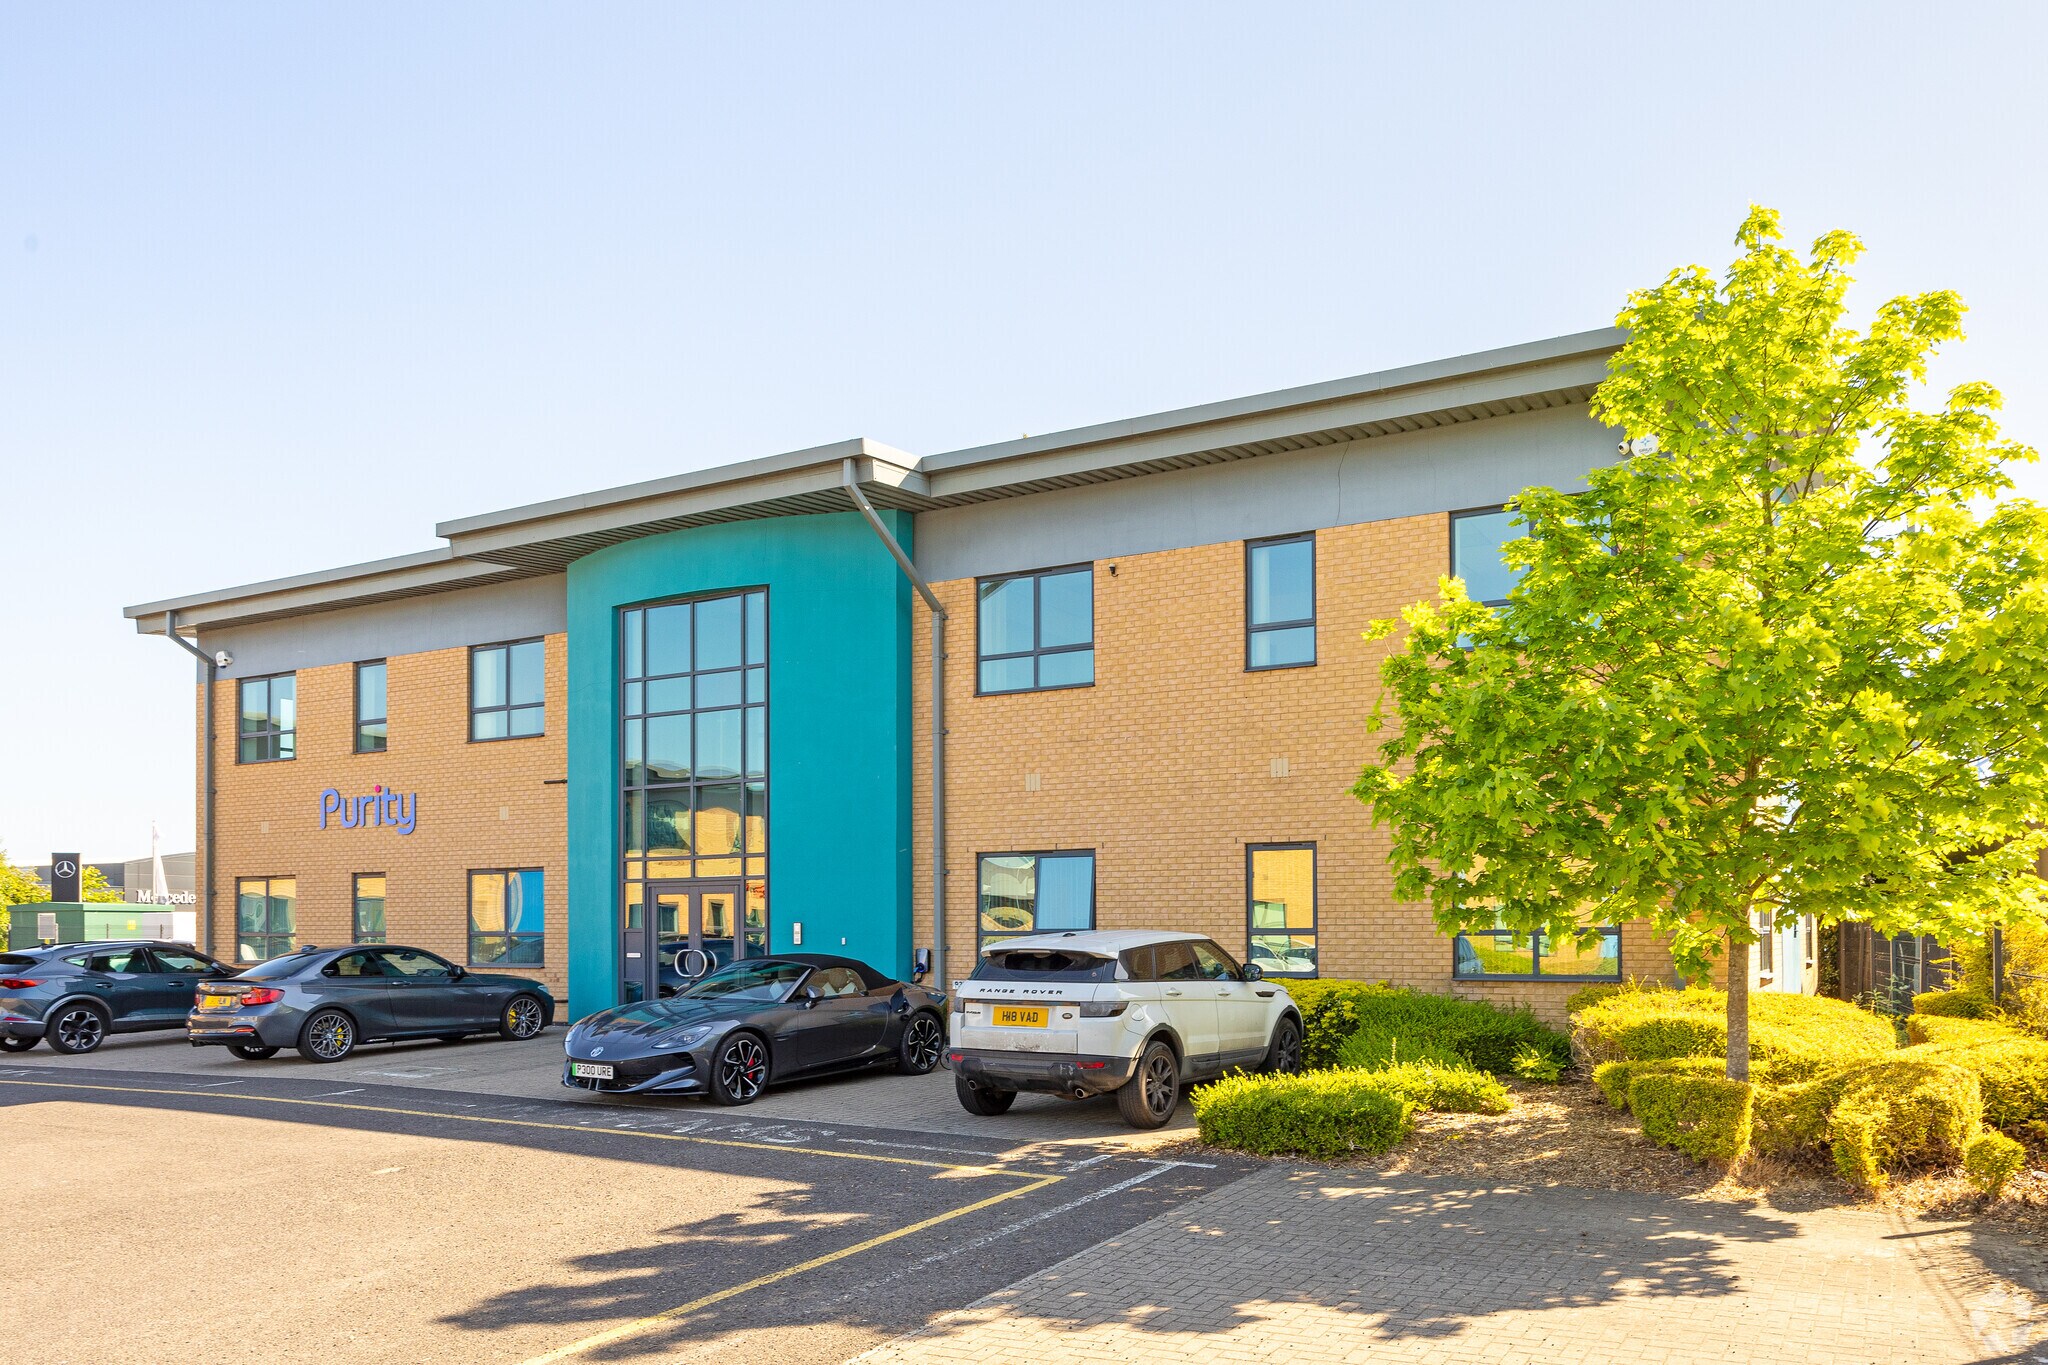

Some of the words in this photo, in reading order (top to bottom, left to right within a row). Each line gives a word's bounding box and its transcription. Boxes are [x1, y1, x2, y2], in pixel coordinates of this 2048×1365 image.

[320, 784, 417, 835] Purity
[1020, 1011, 1039, 1023] VAD
[576, 1064, 596, 1076] P300
[597, 1065, 612, 1077] URE
